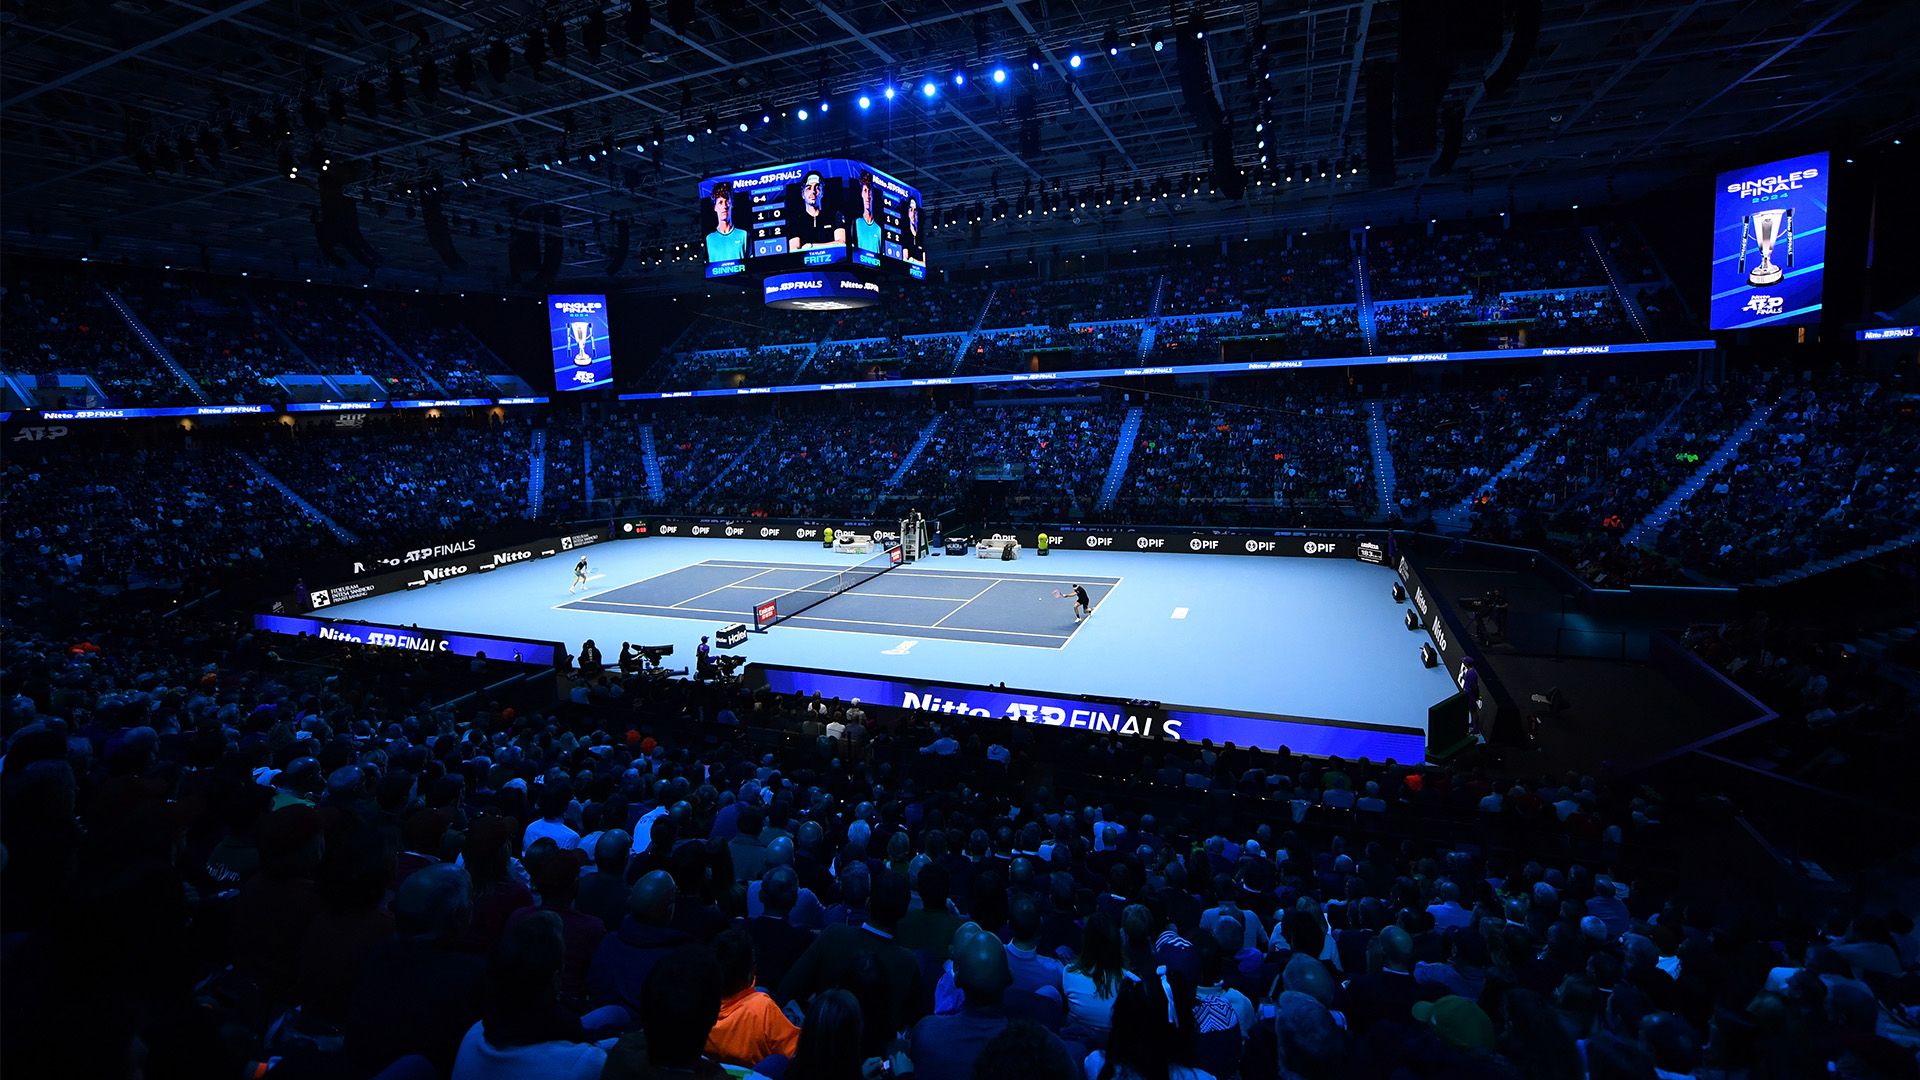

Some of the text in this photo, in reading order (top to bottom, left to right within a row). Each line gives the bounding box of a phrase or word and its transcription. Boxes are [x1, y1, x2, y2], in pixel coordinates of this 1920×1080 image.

[733, 169, 802, 189] Nitto ATP FINALS
[1727, 168, 1819, 193] SINGLES
[1740, 181, 1803, 199] FINAL
[1751, 192, 1790, 203] 2024
[757, 210, 781, 220] 1 0
[758, 227, 781, 237] 2 2
[759, 244, 783, 254] 0 0
[803, 254, 832, 265] FRITZ
[859, 254, 881, 267] SINNER
[712, 264, 746, 275] SINNER
[794, 280, 823, 289] FINALS
[840, 280, 864, 289] Nitto
[1741, 297, 1784, 311] ATP
[1756, 306, 1783, 315] FINALS
[10, 426, 69, 442] ATP
[699, 526, 710, 534] PIF
[768, 528, 780, 536] PIF
[1048, 536, 1064, 545] PIF
[1097, 538, 1113, 546] PIF
[1148, 539, 1165, 548] PIF
[1202, 540, 1219, 549] PIF
[403, 547, 433, 564] ATP
[434, 539, 476, 557] FINALS
[1258, 542, 1276, 551] PIF
[1317, 543, 1336, 553] PIF
[493, 551, 532, 565] Nitto
[423, 565, 468, 581] Nitto
[1414, 586, 1428, 615] Nitto
[728, 630, 747, 645] Haier
[1432, 615, 1447, 651] Nitto
[319, 627, 449, 652] Nitto ATP FINALS
[902, 691, 1183, 740] Nitto ATP FINALS
